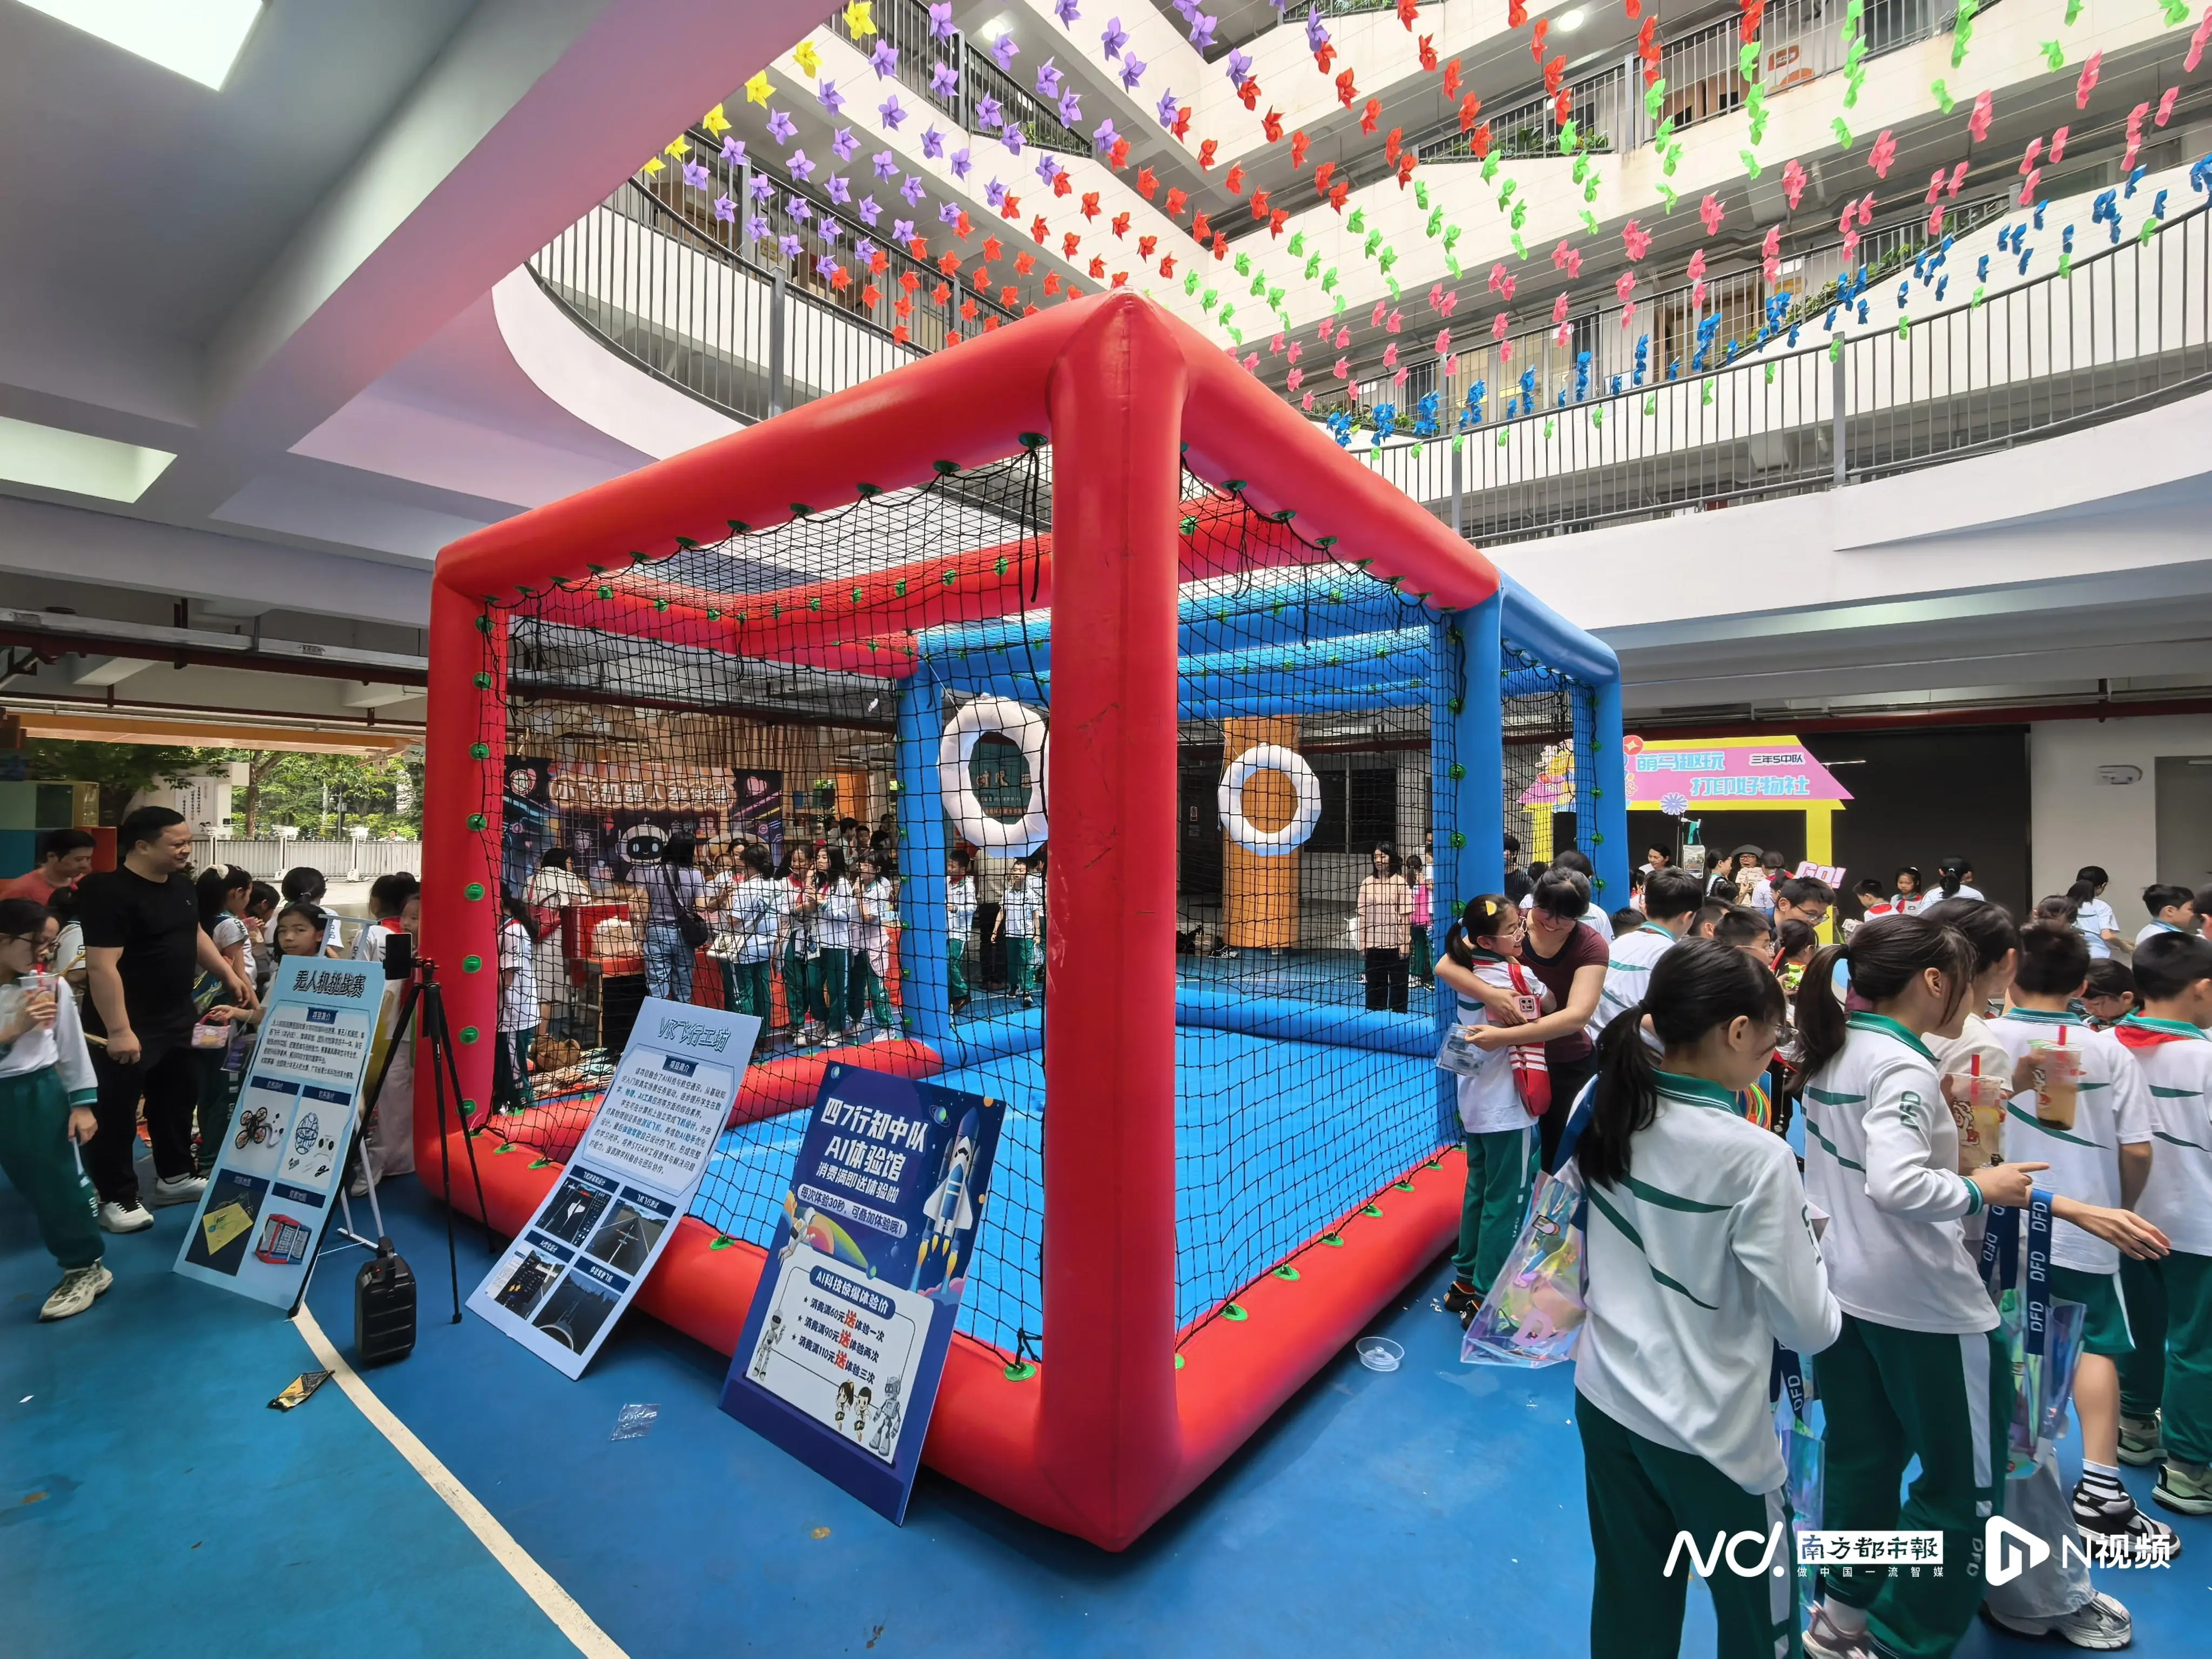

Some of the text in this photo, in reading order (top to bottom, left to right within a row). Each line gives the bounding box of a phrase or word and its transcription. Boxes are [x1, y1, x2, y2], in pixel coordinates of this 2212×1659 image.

[1636, 752, 1725, 771] 萌马趣玩
[1691, 776, 1810, 795] 打印好物社
[293, 970, 366, 999] 无人机挑战赛
[658, 1017, 731, 1053] VR飞行工坊
[820, 1097, 930, 1153] 四7行知中队
[823, 1132, 907, 1183] AI体验馆
[815, 1162, 900, 1204] 消费满即送体验啦
[2032, 1201, 2047, 1232] DFD
[1982, 1232, 1998, 1262] DFD
[2029, 1251, 2046, 1282] DFD
[814, 1269, 891, 1316] AI科技惊爆体验价
[810, 1297, 885, 1343] 消费满60元送体验一次
[2029, 1301, 2044, 1332] DFD
[803, 1316, 880, 1364] 消费满90元送体验两次
[798, 1334, 876, 1386] 消费满110元送体验三次
[1788, 1375, 1803, 1411] DFD
